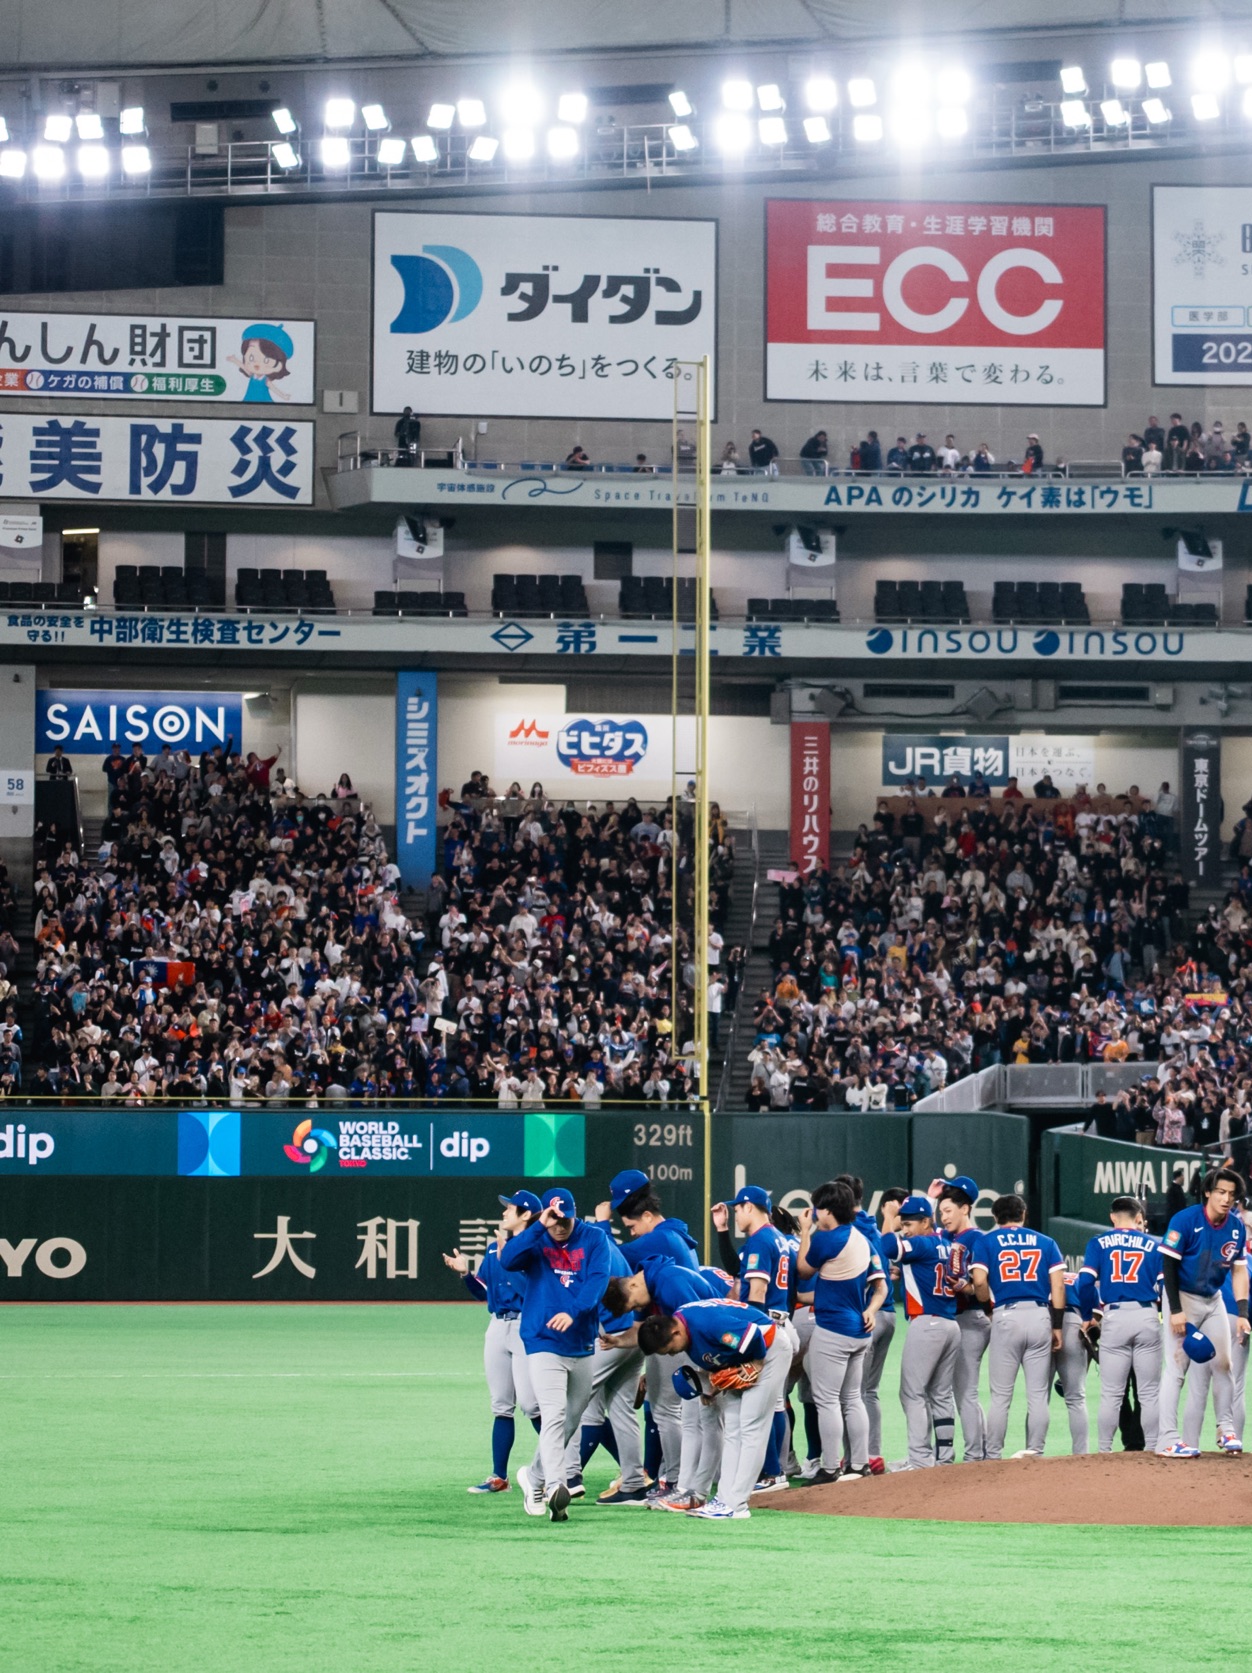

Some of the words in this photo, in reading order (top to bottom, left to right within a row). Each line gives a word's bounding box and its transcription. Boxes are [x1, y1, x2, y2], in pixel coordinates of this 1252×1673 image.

[816, 213, 1055, 237] 総合教育・生涯学習機関
[500, 265, 703, 326] ダイダン
[807, 245, 1064, 335] ECC
[1188, 310, 1229, 322] 医学部
[405, 348, 694, 382] 建物の「いのち」をつくる。
[808, 359, 1065, 386] 未来は、言葉で変わる。
[0, 371, 19, 388] 業
[48, 373, 124, 391] ケガの補償
[152, 376, 215, 393] 福利厚生
[0, 419, 302, 500] 美防災
[594, 489, 640, 502] Space
[824, 485, 883, 507] APA
[7, 614, 85, 629] 食品の安全を
[89, 617, 342, 646] 中部衛生検査センター
[46, 703, 225, 743] SAISON
[558, 730, 646, 756] ビヒダス
[405, 696, 429, 844] シミズオクト
[888, 747, 1005, 777] JR貨物
[7, 778, 25, 791] 58
[802, 736, 820, 874] 三井のリハウス
[1194, 757, 1209, 876] 東京ドームツアー
[338, 1121, 400, 1134] WORLD
[633, 1124, 693, 1147] 329ft
[0, 1124, 55, 1165] dip
[338, 1134, 423, 1148] BASEBALL
[439, 1131, 491, 1163] dip
[648, 1164, 693, 1181] 100m
[1093, 1161, 1157, 1194] MIWA
[997, 1233, 1037, 1247] C.C.LIN
[1097, 1233, 1156, 1252] FAIRCHILD
[1231, 1229, 1240, 1240] C
[998, 1249, 1042, 1283] 27
[1110, 1250, 1145, 1283] 17
